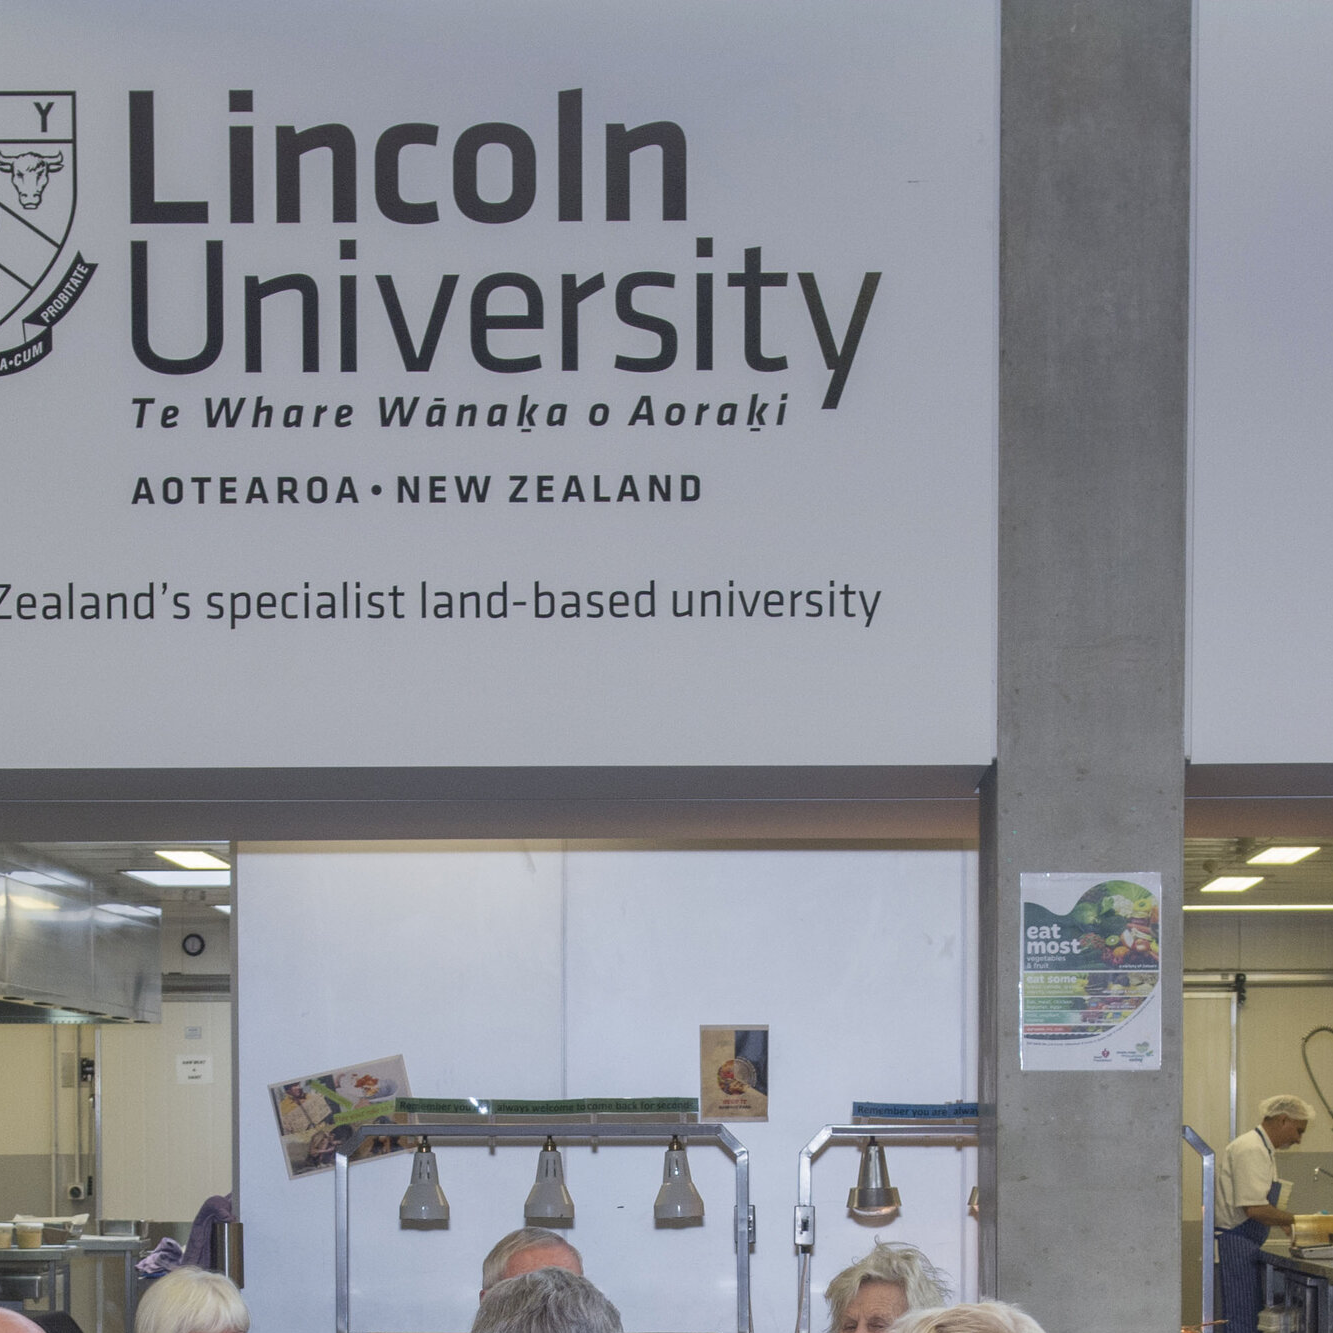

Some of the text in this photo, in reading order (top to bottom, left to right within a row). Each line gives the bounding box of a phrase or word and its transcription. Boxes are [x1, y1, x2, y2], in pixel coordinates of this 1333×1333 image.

[129, 88, 686, 225] Lincoln
[39, 262, 90, 323] PROBITATE
[131, 238, 882, 409] University
[132, 398, 180, 429] Te
[205, 396, 354, 429] Whare
[589, 403, 610, 427] o
[398, 475, 492, 504] NEW
[509, 474, 701, 503] ZEALAND
[206, 581, 405, 630] specialist
[421, 580, 656, 619] land-based
[672, 580, 882, 628] university
[1026, 923, 1061, 940] eat
[1027, 938, 1081, 954] most
[1027, 955, 1066, 963] vegetables
[1027, 976, 1077, 984] eat some
[399, 1101, 451, 1111] Remember
[454, 1103, 471, 1113] you
[497, 1102, 529, 1114] always
[533, 1102, 573, 1112] welcome
[577, 1103, 585, 1112] to
[616, 1102, 637, 1110] back
[641, 1101, 654, 1110] for
[858, 1105, 909, 1115] Remember
[912, 1108, 929, 1118] you
[954, 1106, 978, 1116] alwa
